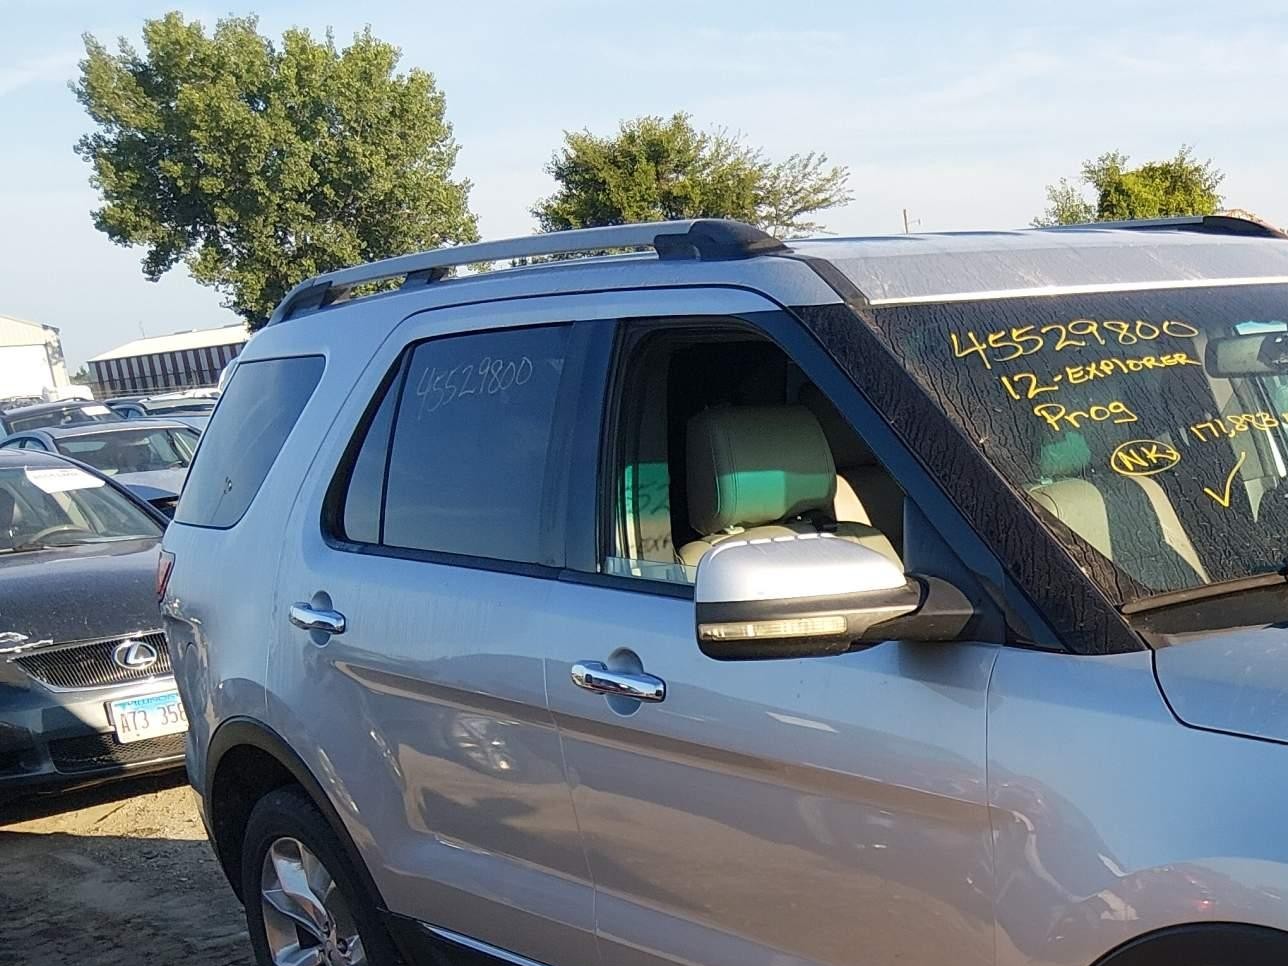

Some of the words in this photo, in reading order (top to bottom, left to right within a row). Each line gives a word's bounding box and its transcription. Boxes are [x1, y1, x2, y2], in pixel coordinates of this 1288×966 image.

[950, 320, 1199, 370] 45529800
[416, 356, 533, 421] 45529800
[1034, 401, 1138, 431] Prog
